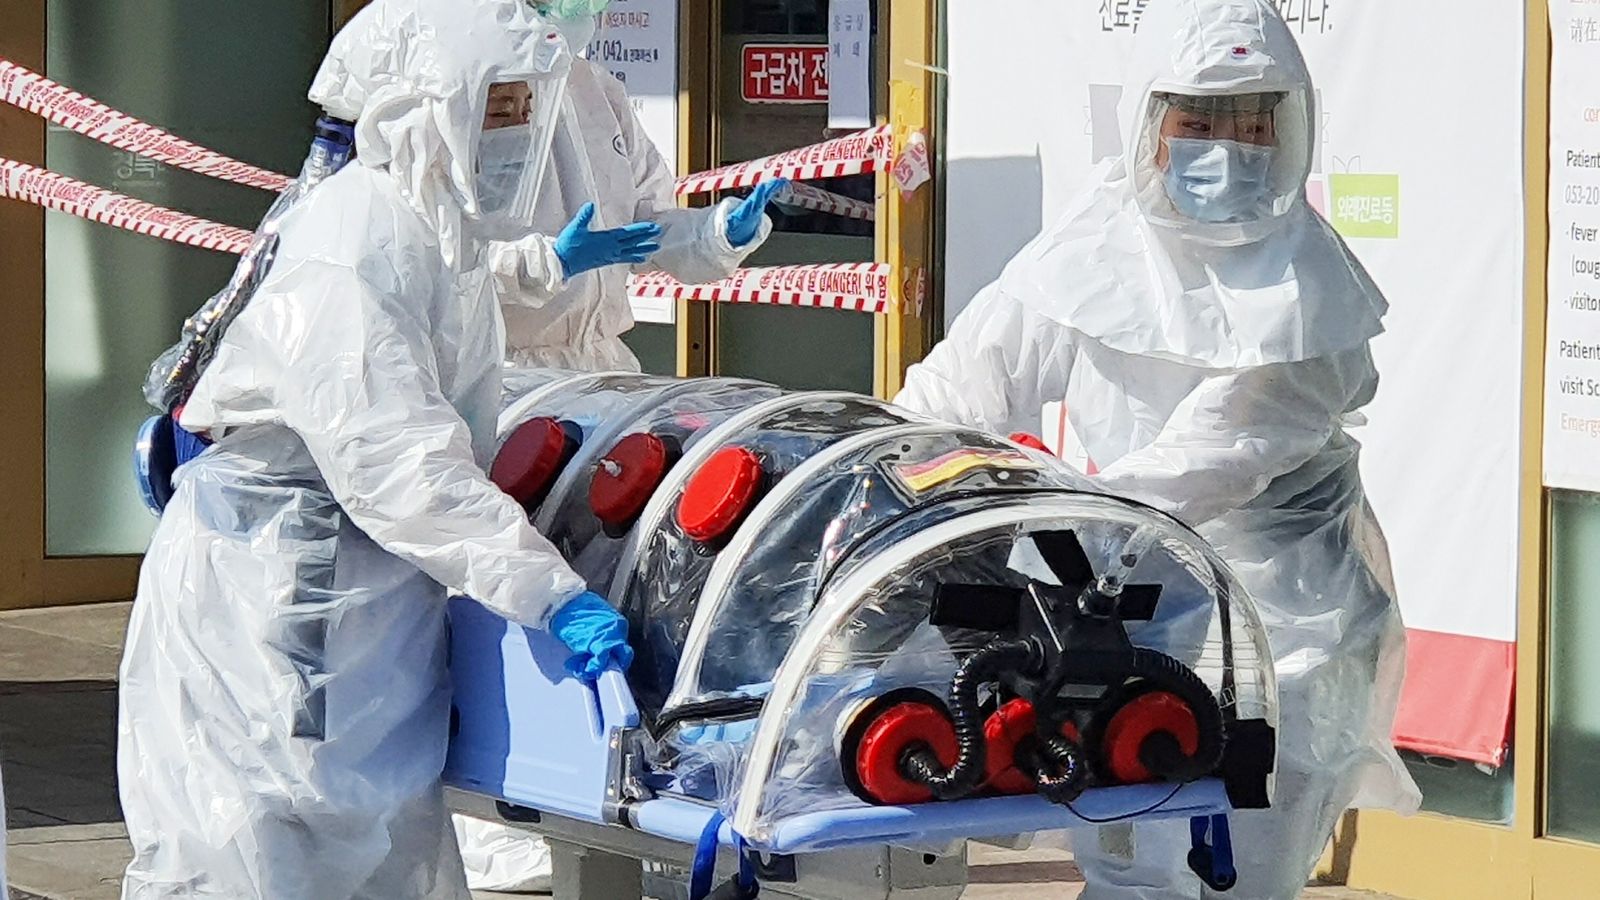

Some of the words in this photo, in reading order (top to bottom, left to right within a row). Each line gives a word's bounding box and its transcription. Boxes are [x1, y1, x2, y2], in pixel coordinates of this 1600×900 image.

[1270, 0, 1332, 34] 니다.
[1571, 17, 1600, 42] 请在
[750, 51, 805, 96] 구급차
[1571, 222, 1597, 242] fever
[819, 272, 861, 297] DANGER!
[1559, 376, 1583, 396] visit
